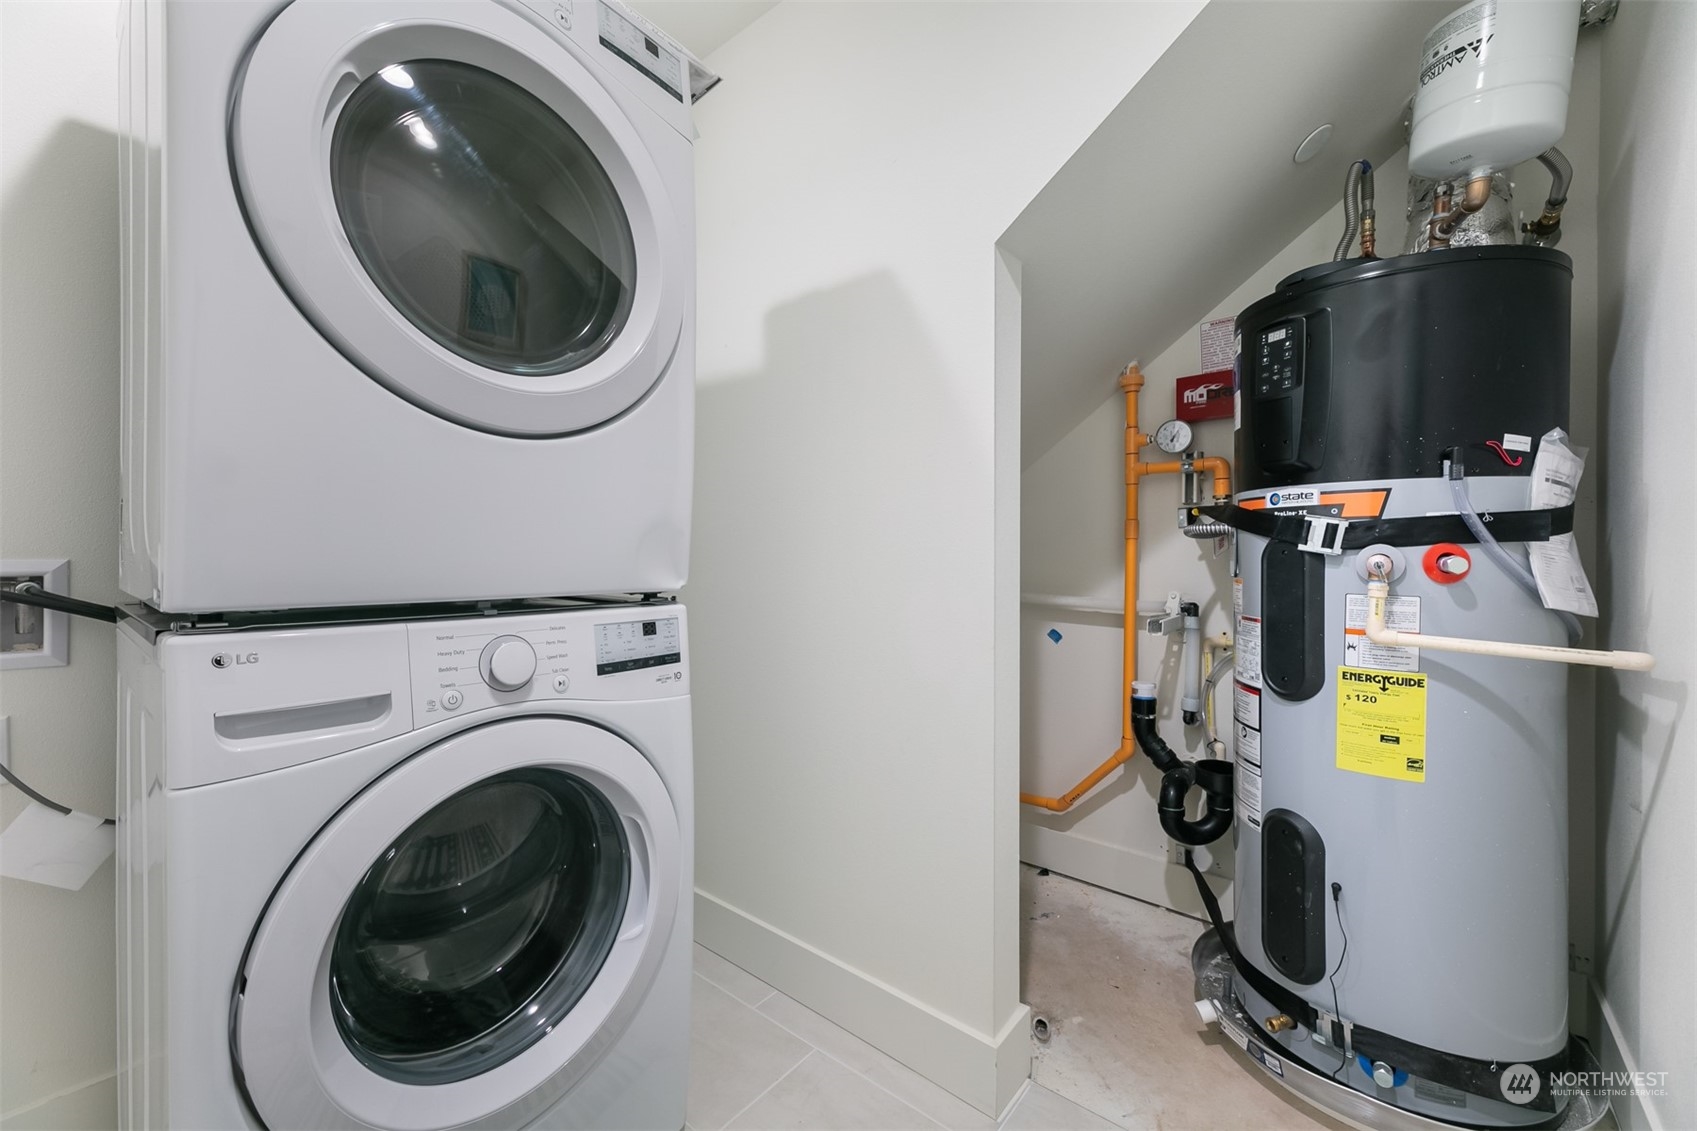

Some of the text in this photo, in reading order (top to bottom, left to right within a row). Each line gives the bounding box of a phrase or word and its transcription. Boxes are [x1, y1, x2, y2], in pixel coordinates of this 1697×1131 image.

[1281, 492, 1314, 501] state
[236, 653, 259, 665] LG
[1342, 671, 1425, 690] ENERGYGUIDE
[1355, 694, 1377, 704] 120
